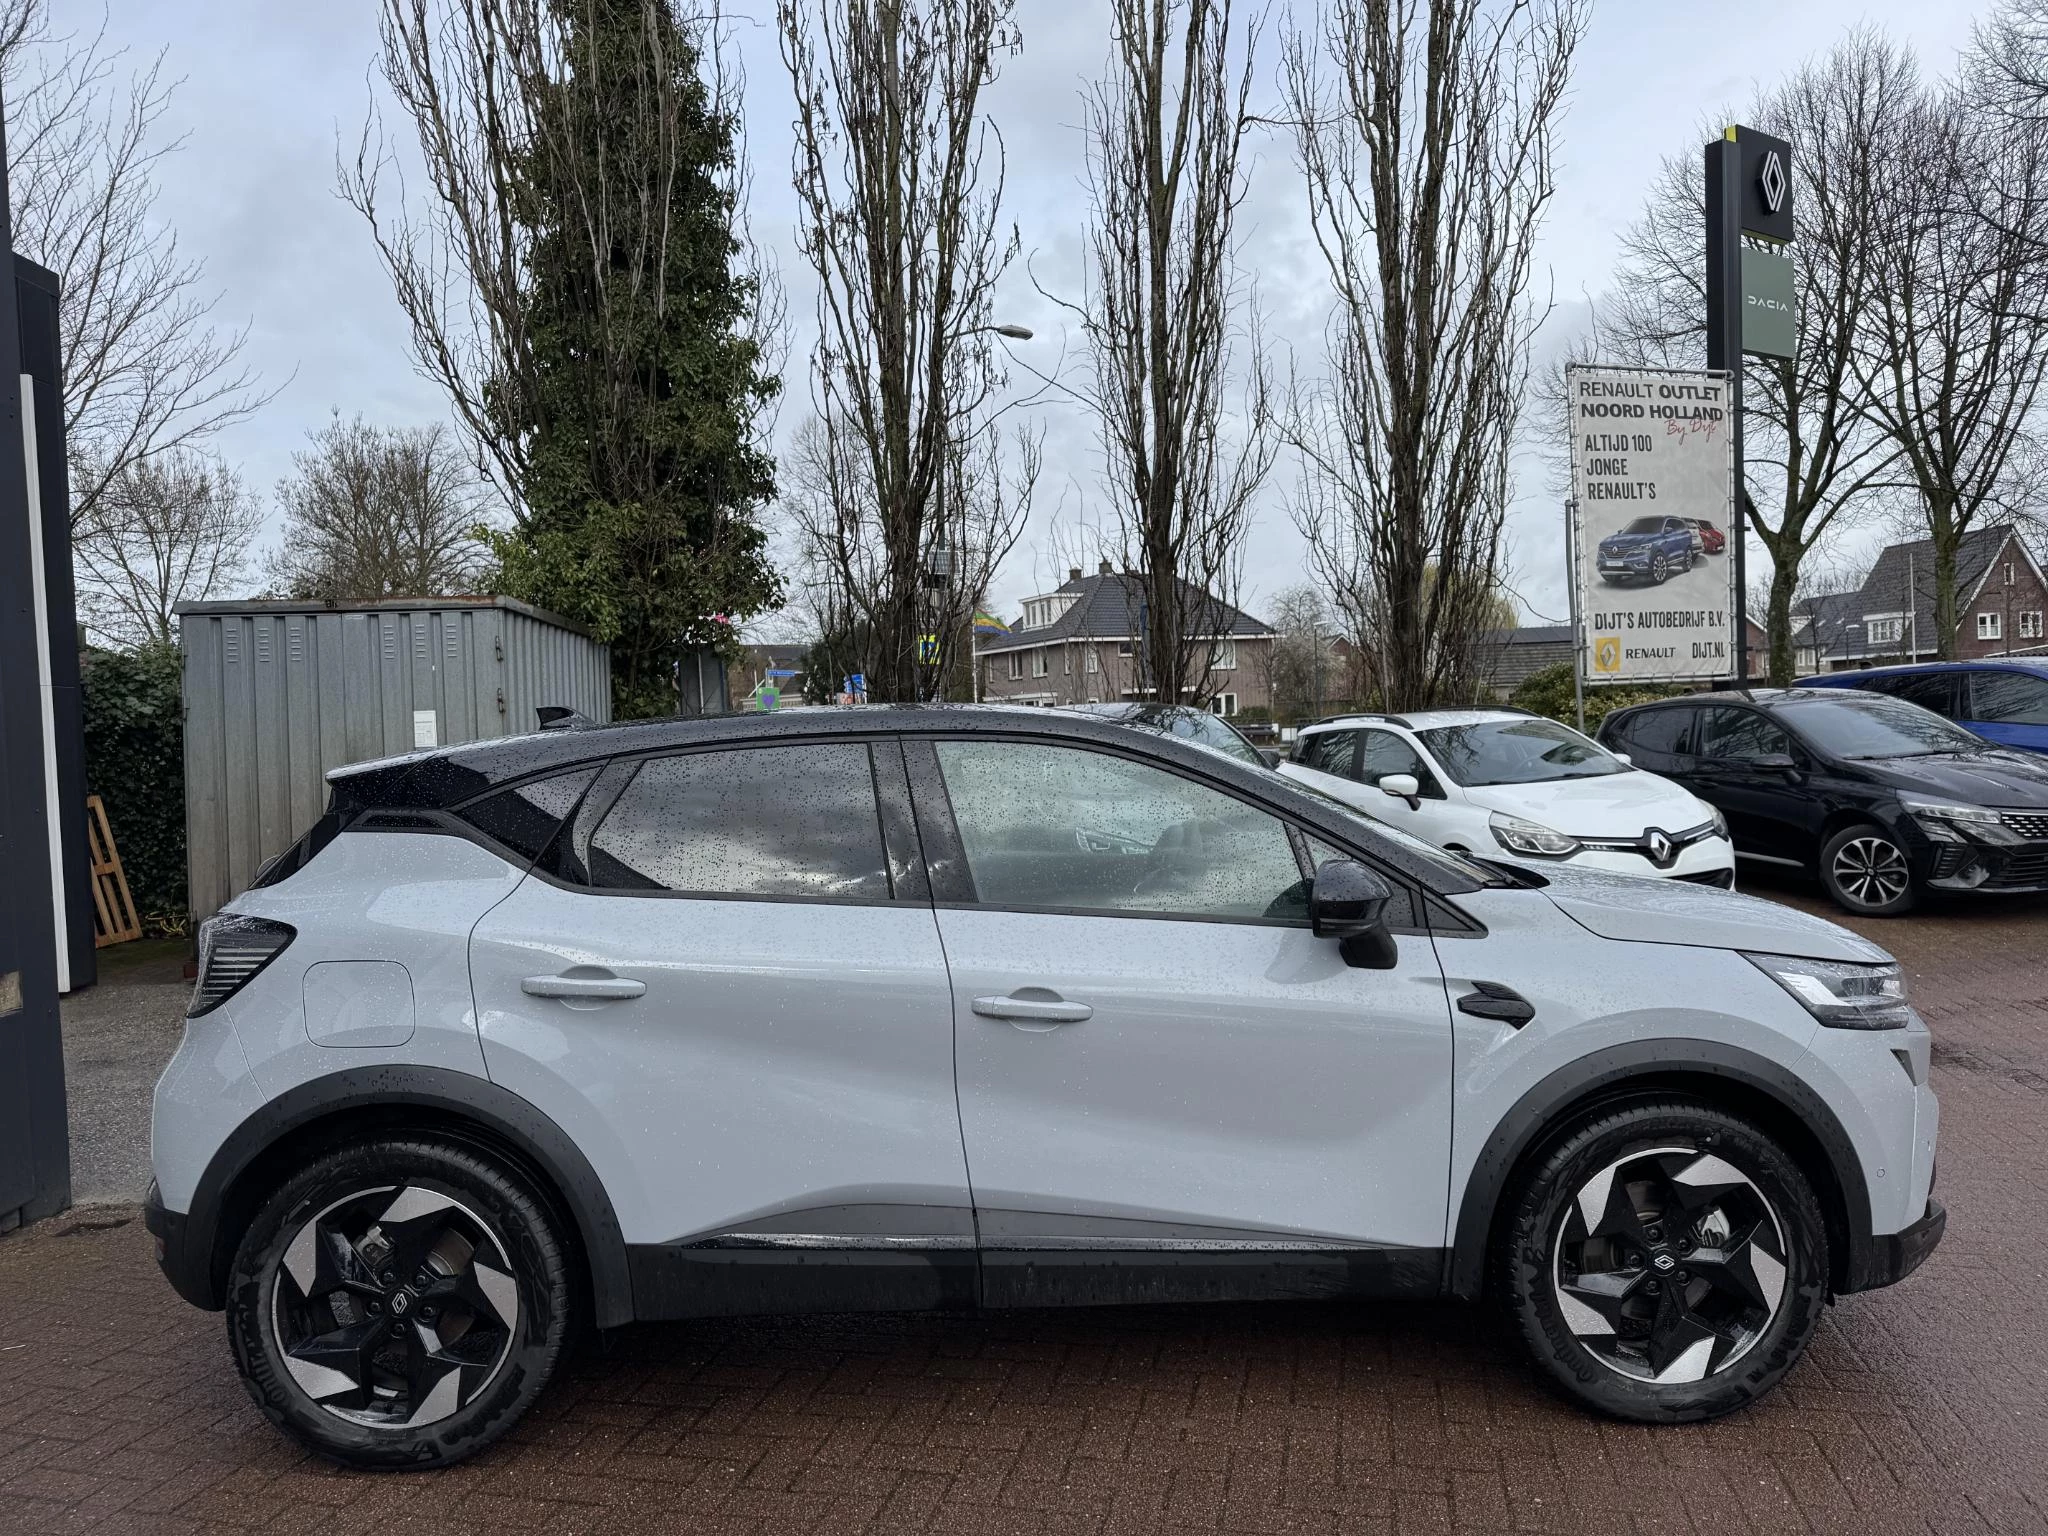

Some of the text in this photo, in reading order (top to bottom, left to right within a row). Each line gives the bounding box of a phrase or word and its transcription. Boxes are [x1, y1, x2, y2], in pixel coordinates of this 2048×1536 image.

[1747, 295, 1789, 312] DACIA
[1580, 381, 1721, 402] RENAULT OUTLET
[1581, 403, 1723, 421] NOORD HOLLAND
[1664, 419, 1687, 445] By
[1585, 434, 1653, 452] ALTIJD 100
[1586, 458, 1628, 476] JONGE
[1587, 482, 1656, 500] RENAULT'S
[1594, 610, 1725, 630] DIJT'S AUTOBEDRIJF B.V.
[1625, 647, 1676, 659] RENAULT
[1692, 641, 1725, 659] DIJT.NL
